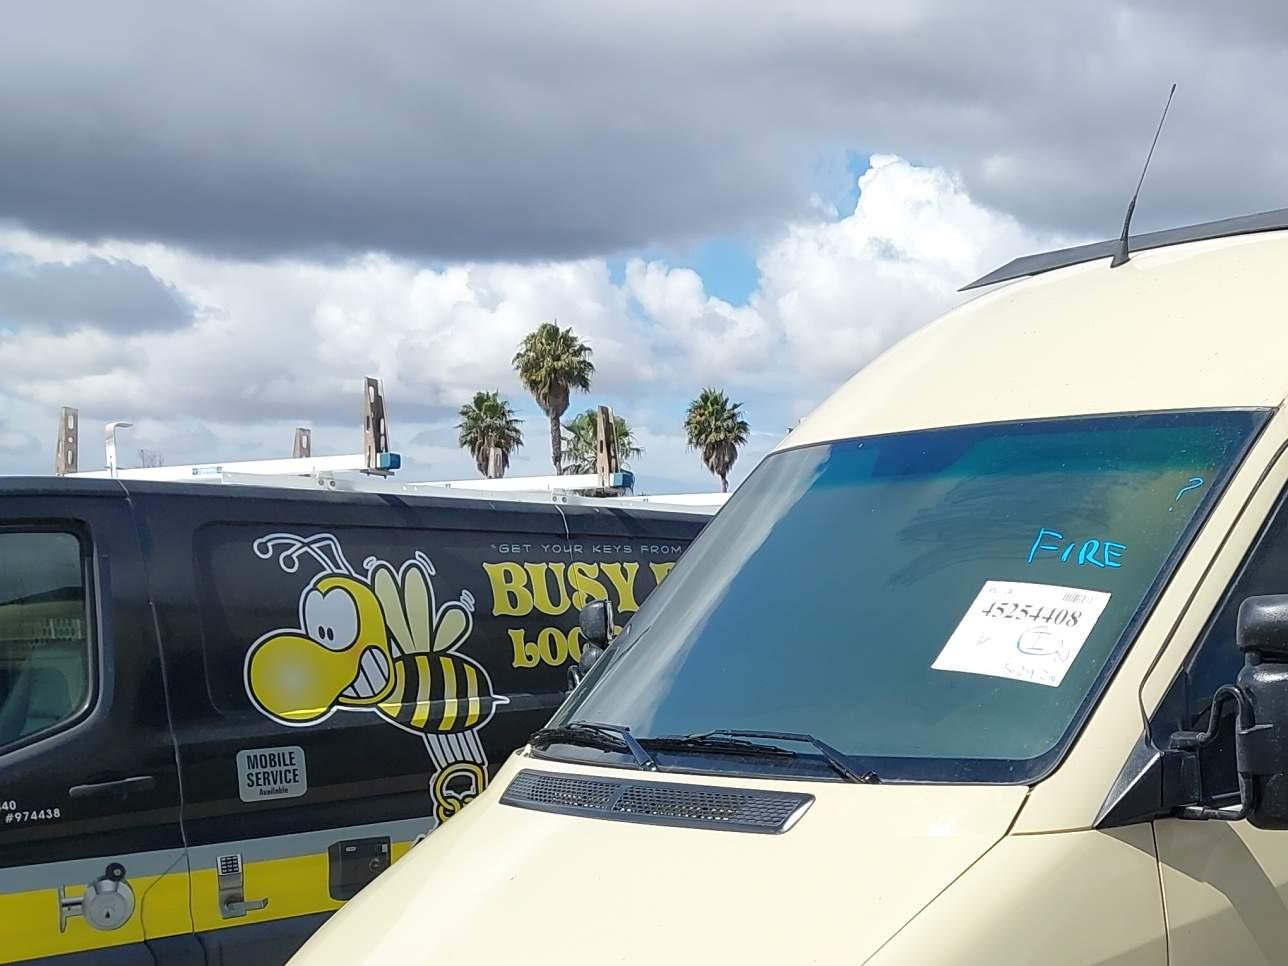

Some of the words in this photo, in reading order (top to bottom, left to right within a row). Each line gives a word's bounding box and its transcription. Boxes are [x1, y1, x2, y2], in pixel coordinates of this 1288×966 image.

[541, 543, 583, 554] YOUR
[592, 544, 633, 554] KEYS
[640, 544, 682, 555] FROM
[1028, 528, 1127, 568] FIRE
[482, 561, 640, 617] BUSY
[980, 600, 1083, 628] 45254408
[246, 751, 297, 770] MOBILE
[246, 768, 300, 788] SERVICE
[5, 807, 61, 824] #974438
